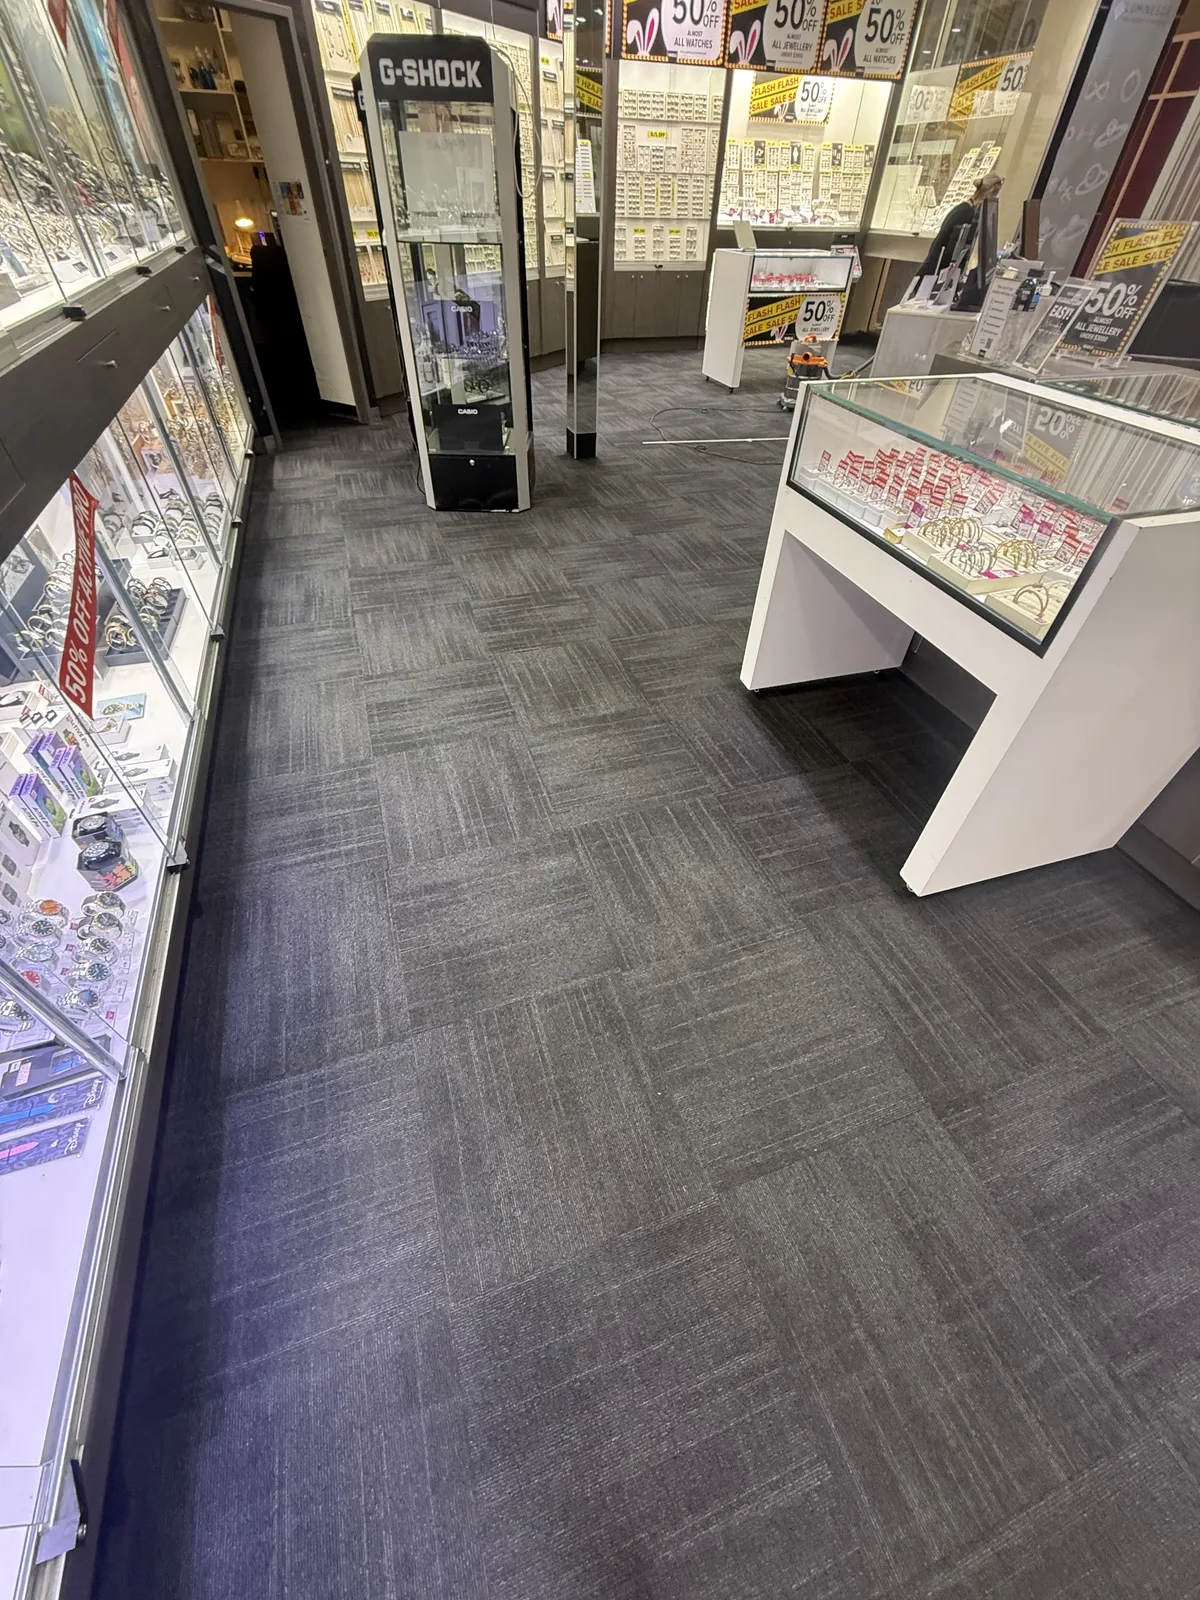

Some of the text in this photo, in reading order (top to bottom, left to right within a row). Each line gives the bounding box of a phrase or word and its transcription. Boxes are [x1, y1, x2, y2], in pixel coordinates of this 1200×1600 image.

[774, 0, 818, 32] 50% OFF
[829, 2, 853, 20] SALE
[703, 15, 720, 29] OFF
[865, 7, 906, 44] 50%
[890, 33, 906, 45] OFF
[674, 37, 713, 49] ALL WATCHES
[772, 40, 813, 52] ALL JEWELLERY
[863, 54, 896, 65] ALL WATCHES
[378, 57, 483, 89] G-SHOCK
[754, 76, 799, 97] FLASH FLASH
[800, 80, 827, 103] 50%
[752, 100, 768, 112] SALE
[770, 94, 787, 107] SALE
[1123, 235, 1159, 250] FLASH
[1113, 255, 1140, 269] SALE
[1143, 248, 1172, 263] SALE
[451, 304, 473, 313] CASIO
[747, 297, 800, 322] FLASH FLASH
[802, 300, 835, 322] 50% OFF
[1085, 282, 1143, 319] 50% OFF
[1048, 304, 1075, 320] EASY!
[745, 323, 763, 337] SALE
[766, 316, 786, 329] SALE
[1074, 321, 1088, 331] ALL
[1086, 323, 1124, 337] JEWELLERY
[65, 480, 93, 704] 50% OFF ACTIVE PRO
[84, 1079, 103, 1108] Disney
[64, 1122, 85, 1155] Disney
